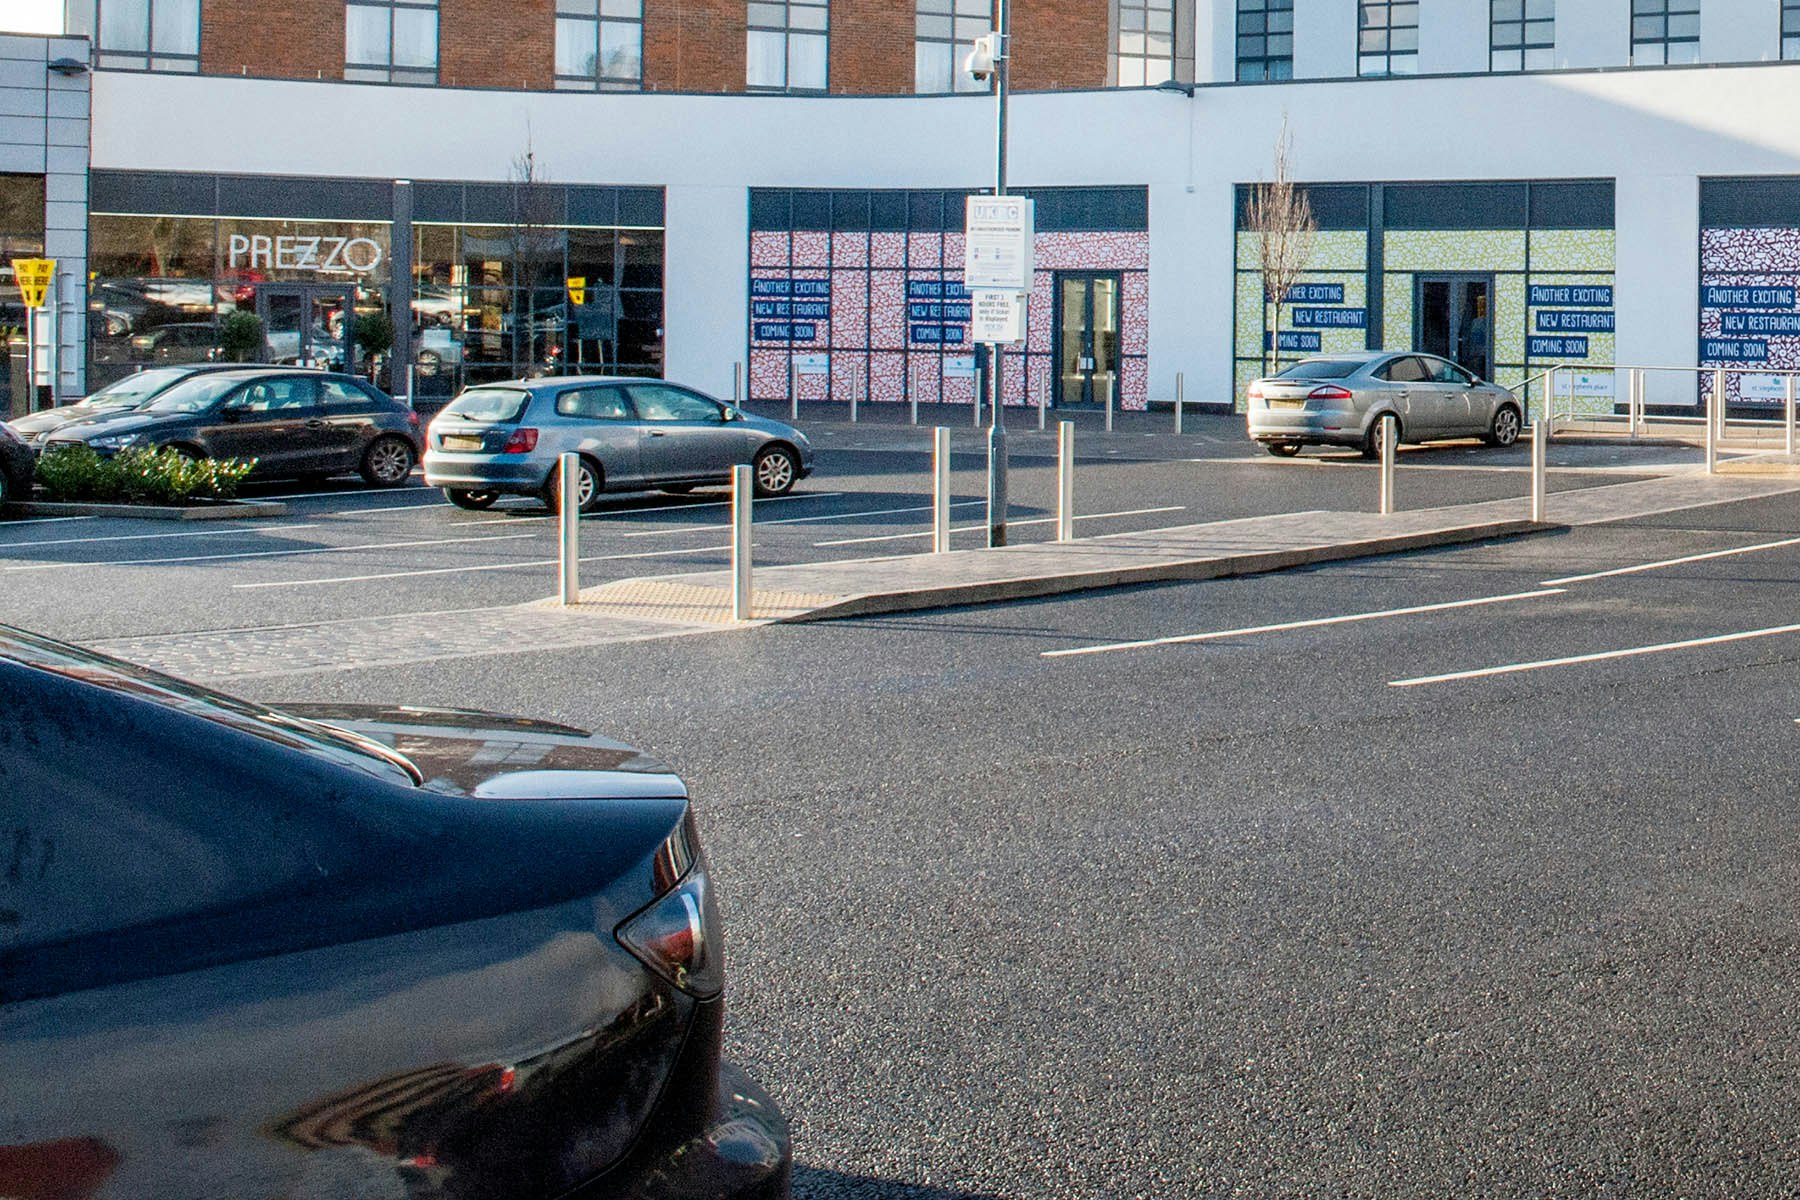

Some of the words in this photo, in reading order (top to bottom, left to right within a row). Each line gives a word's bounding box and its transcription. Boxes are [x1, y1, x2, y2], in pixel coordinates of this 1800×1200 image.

[229, 234, 382, 271] PREZZO
[1531, 286, 1569, 302] ANOTHER
[1573, 288, 1610, 302] EXCITING
[1708, 287, 1749, 303] ANOTHER
[1753, 290, 1792, 304] EXCITING
[755, 303, 774, 315] NEW
[1295, 310, 1312, 323] NEW
[1314, 310, 1364, 324] RESTAURANT
[1540, 314, 1558, 327] NEW
[1561, 314, 1614, 328] RESTAURANT
[1725, 316, 1745, 330] NEW
[795, 326, 814, 338] SOON
[1301, 335, 1319, 347] SOON
[1532, 340, 1562, 353] COMING
[1565, 340, 1586, 353] SOON
[1707, 343, 1739, 357] COMING
[1743, 343, 1765, 357] SOON
